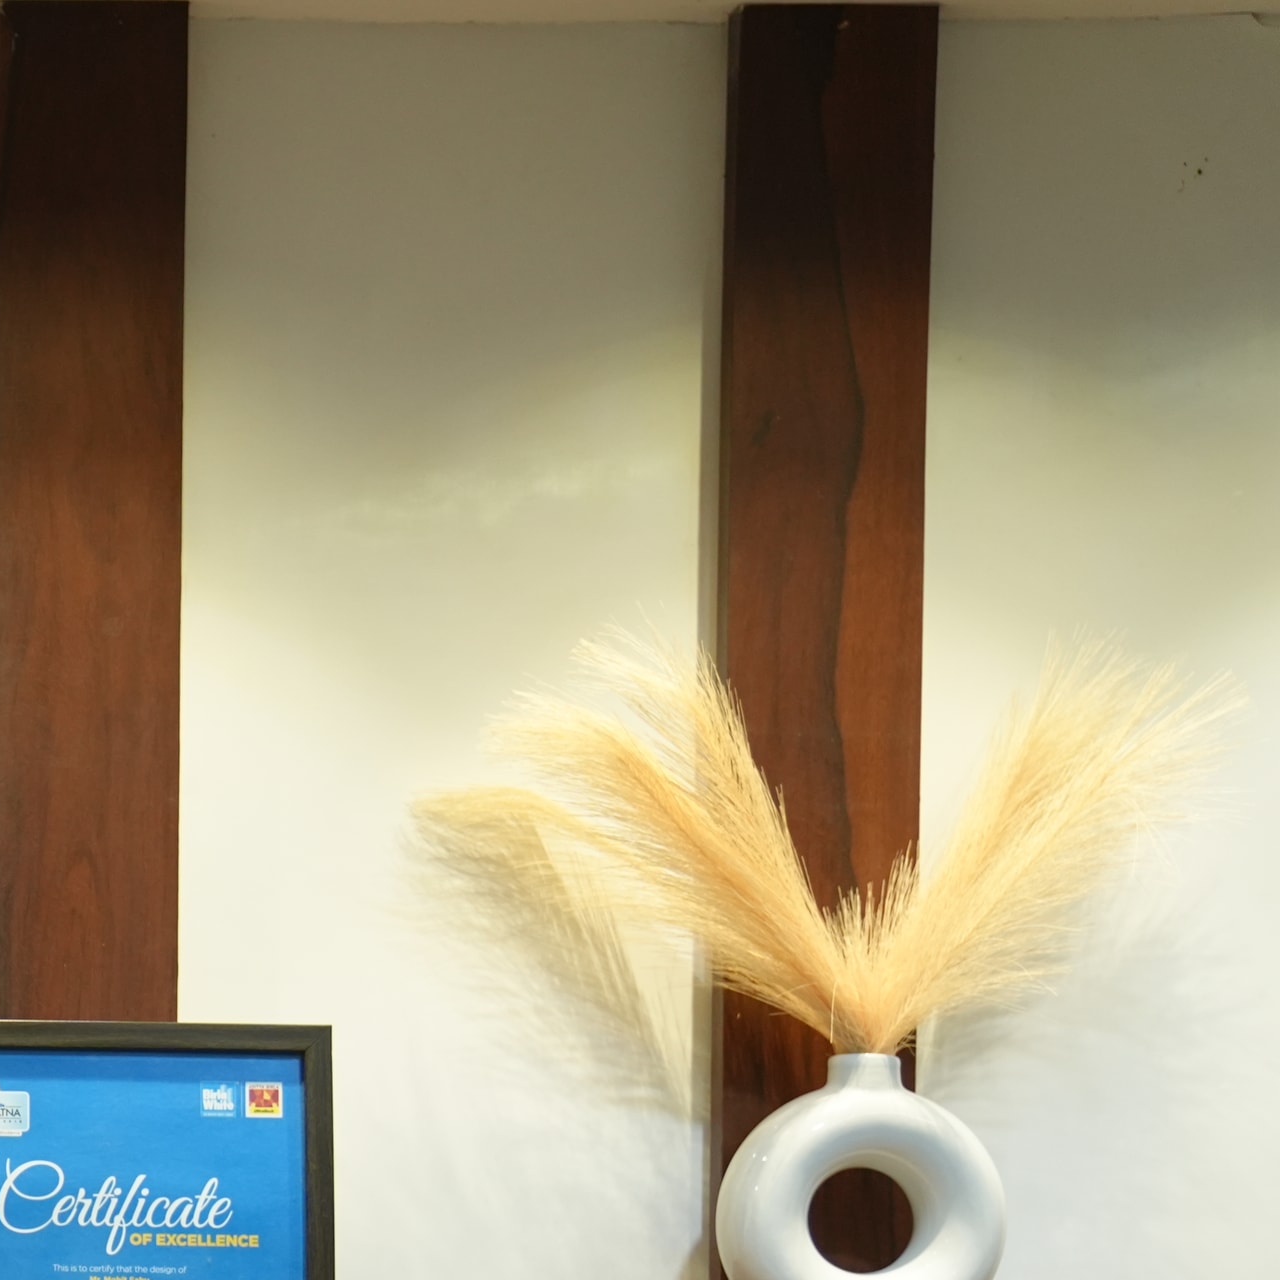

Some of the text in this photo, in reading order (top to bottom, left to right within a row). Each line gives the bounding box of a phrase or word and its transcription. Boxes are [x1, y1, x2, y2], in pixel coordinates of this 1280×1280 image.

[129, 1232, 259, 1248] OF EXCELLENCE
[53, 1264, 68, 1272] This
[71, 1264, 77, 1272] is
[79, 1264, 87, 1272] to
[89, 1264, 114, 1274] certify
[150, 1266, 176, 1275] design
